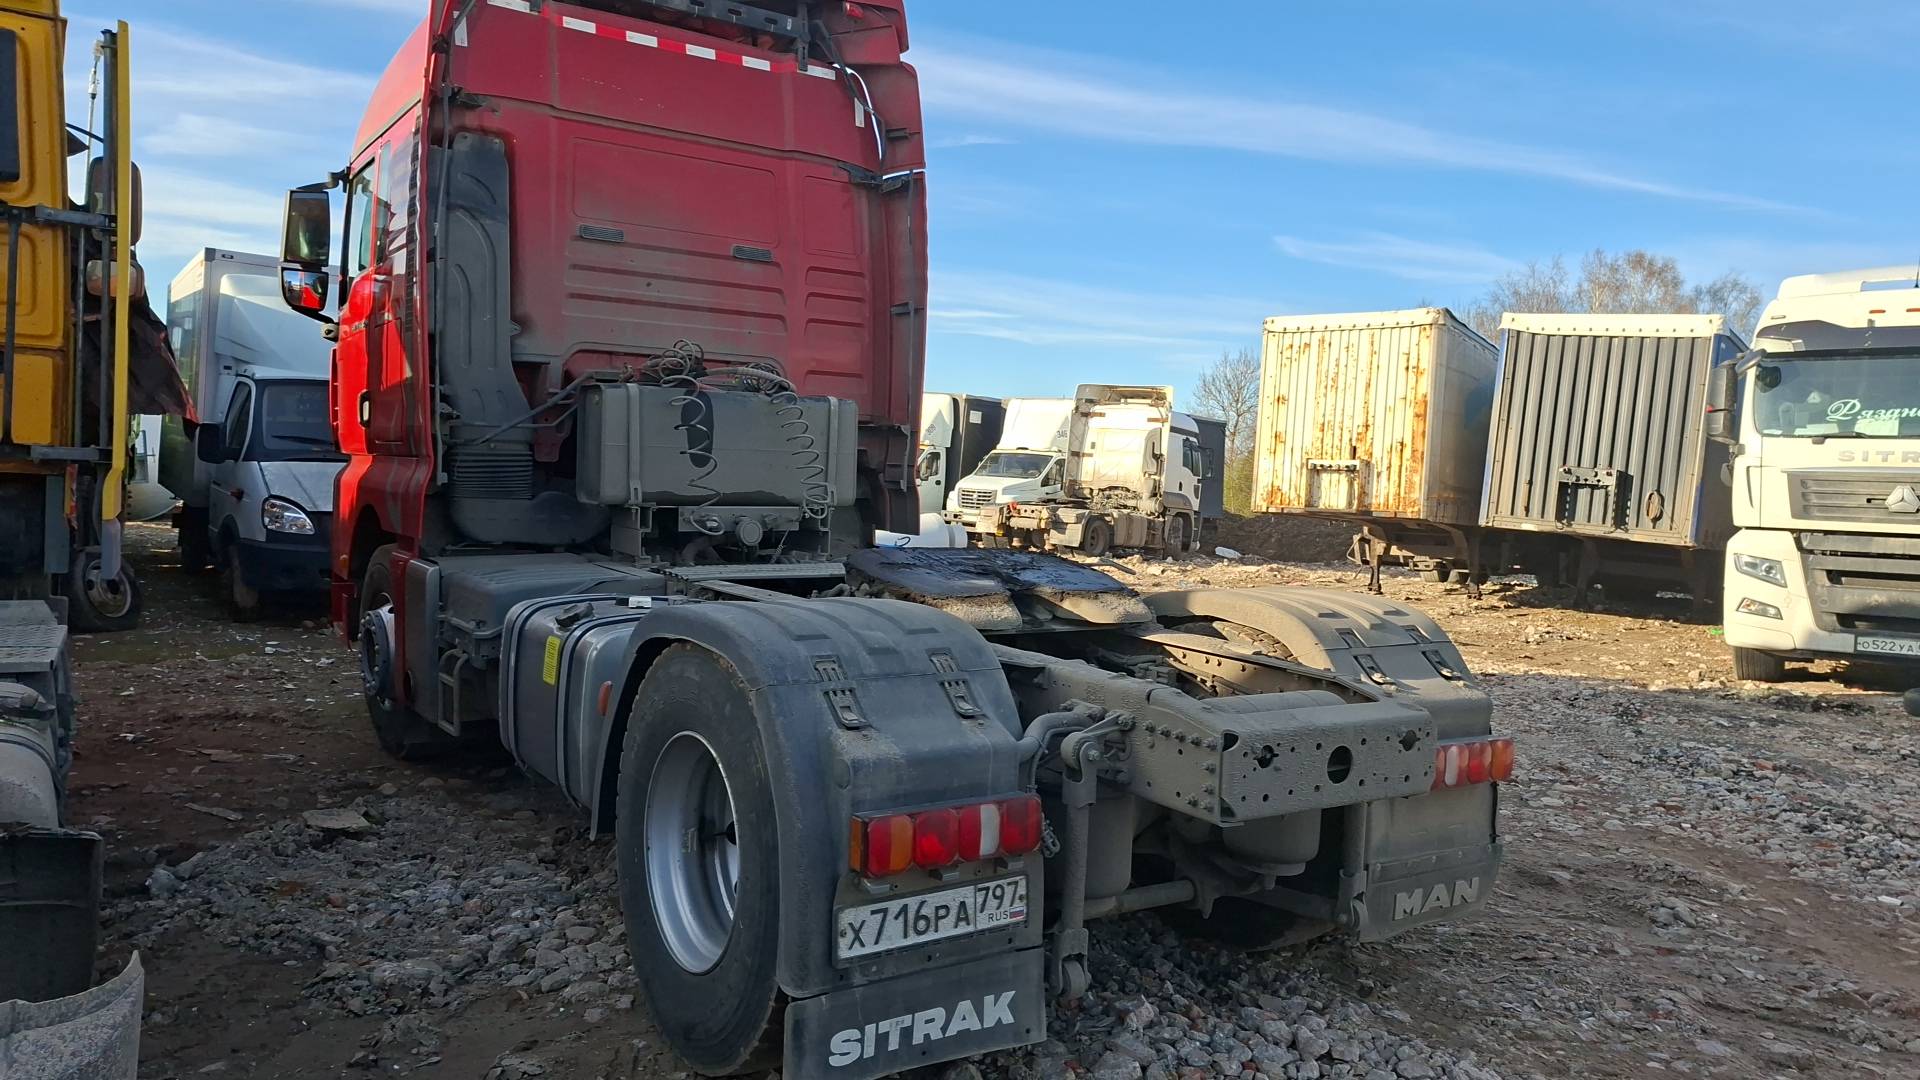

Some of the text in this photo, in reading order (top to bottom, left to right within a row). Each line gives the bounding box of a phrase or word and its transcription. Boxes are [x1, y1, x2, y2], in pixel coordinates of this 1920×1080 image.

[976, 880, 1019, 914] 797
[988, 910, 1009, 922] RUS
[1393, 877, 1480, 920] MAN
[828, 990, 1016, 1067] SITRAK
